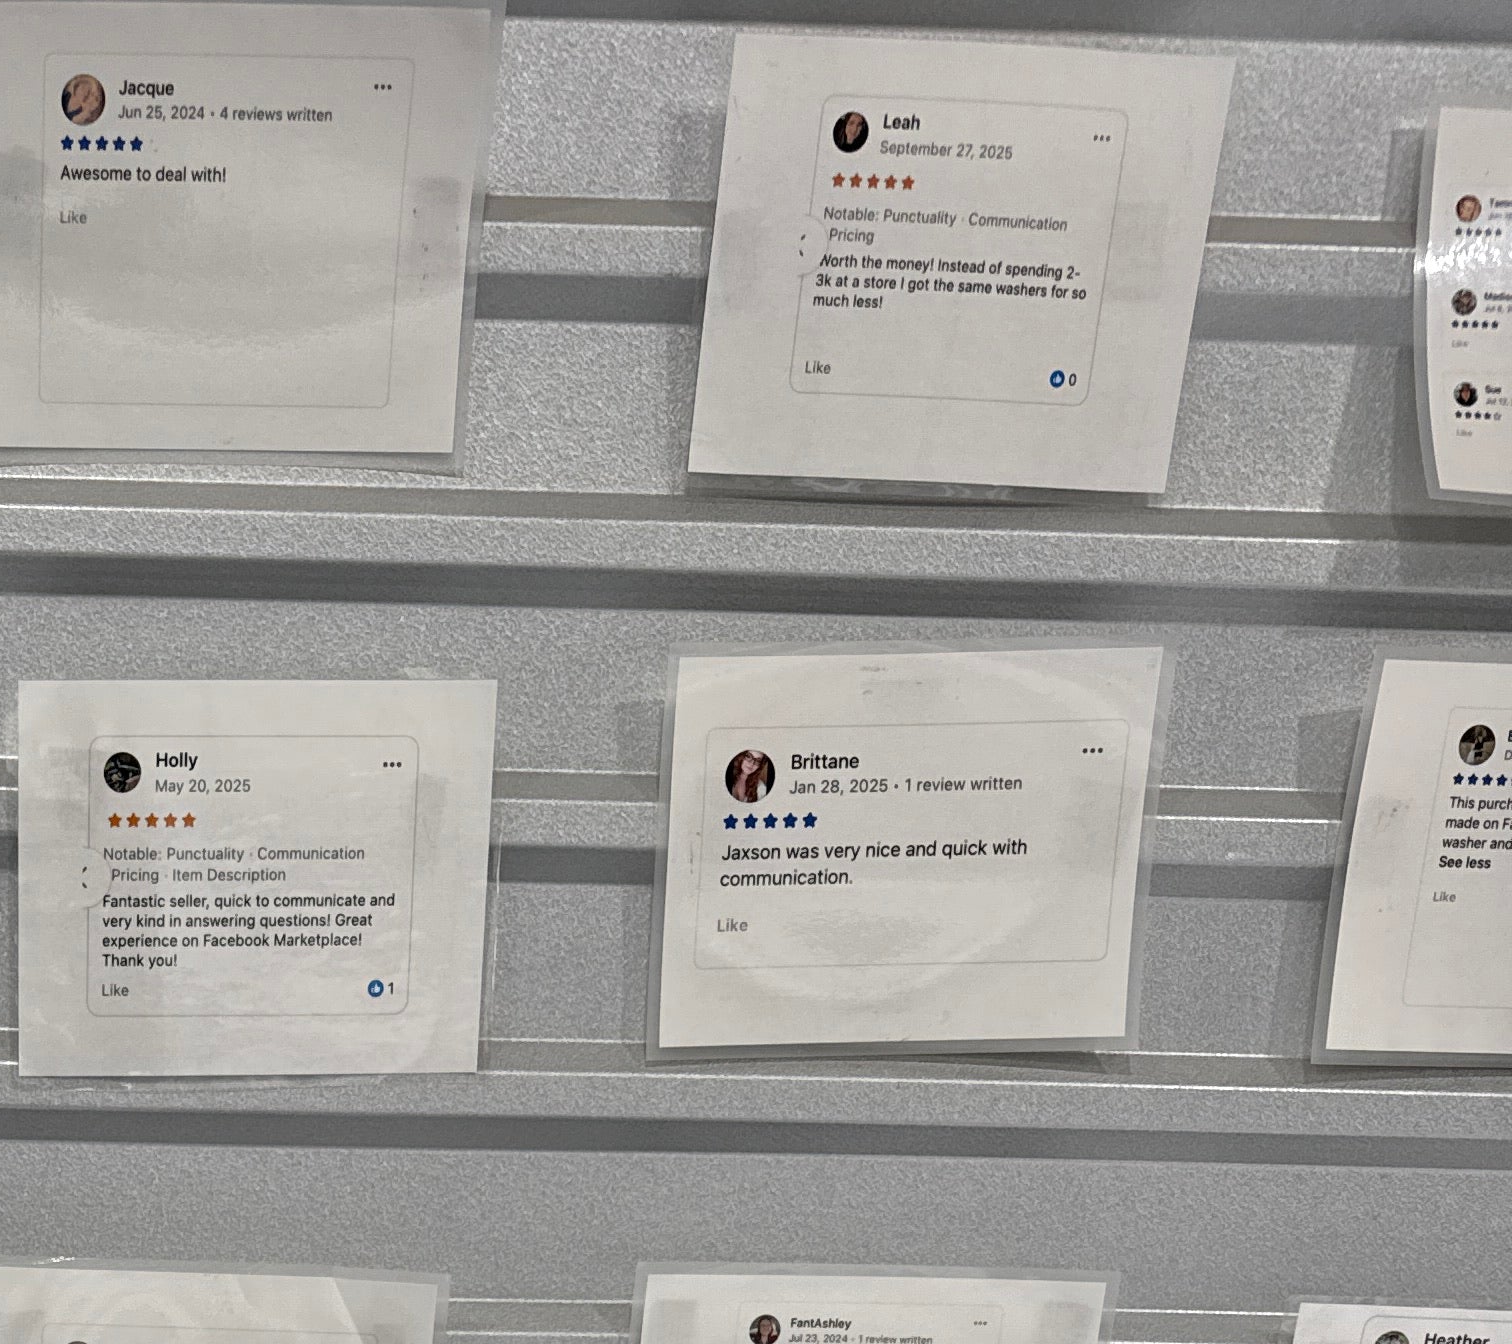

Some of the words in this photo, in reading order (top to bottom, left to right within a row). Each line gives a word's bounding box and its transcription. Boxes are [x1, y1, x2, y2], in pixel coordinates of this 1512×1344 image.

[118, 79, 175, 99] Jacque
[117, 104, 142, 119] Jun
[145, 104, 166, 122] 25,
[170, 104, 205, 120] 2024
[219, 106, 229, 120] 4
[232, 106, 283, 122] reviews
[286, 106, 333, 122] written
[883, 113, 921, 131] Leah
[879, 139, 953, 158] September
[956, 142, 974, 161] 27,
[979, 144, 1013, 161] 2025
[60, 164, 132, 182] Awesome
[136, 166, 152, 182] to
[155, 165, 187, 182] deal
[191, 166, 226, 183] with!
[59, 210, 88, 225] Like
[823, 206, 879, 222] Notable:
[883, 208, 957, 228] Punctuality
[968, 211, 1068, 232] Communication
[828, 227, 875, 246] Pricing
[812, 293, 850, 308] much
[852, 294, 883, 309] less!
[1068, 373, 1077, 387] 0
[156, 751, 198, 771] Holly
[791, 752, 860, 770] Brittane
[155, 779, 185, 796] May
[188, 778, 210, 795] 20,
[214, 778, 251, 793] 2025
[721, 844, 781, 861] Jaxson
[785, 846, 820, 860] was
[824, 845, 861, 862] very
[865, 841, 901, 858] nice
[905, 839, 937, 857] and
[941, 839, 988, 860] quick
[992, 838, 1028, 855] with
[1438, 855, 1463, 869] See
[1465, 855, 1492, 870] less
[111, 867, 159, 885] Pricing
[172, 868, 203, 882] Item
[207, 867, 286, 885] Description
[719, 868, 853, 887] communication.
[717, 917, 749, 933] Like
[102, 933, 178, 950] experience
[181, 936, 199, 948] on
[203, 933, 270, 947] Facebook
[273, 932, 362, 949] Marketplace!
[101, 953, 145, 967] Thank
[148, 953, 177, 970] you!
[387, 982, 394, 995] 1
[790, 1317, 852, 1331] FantAshley
